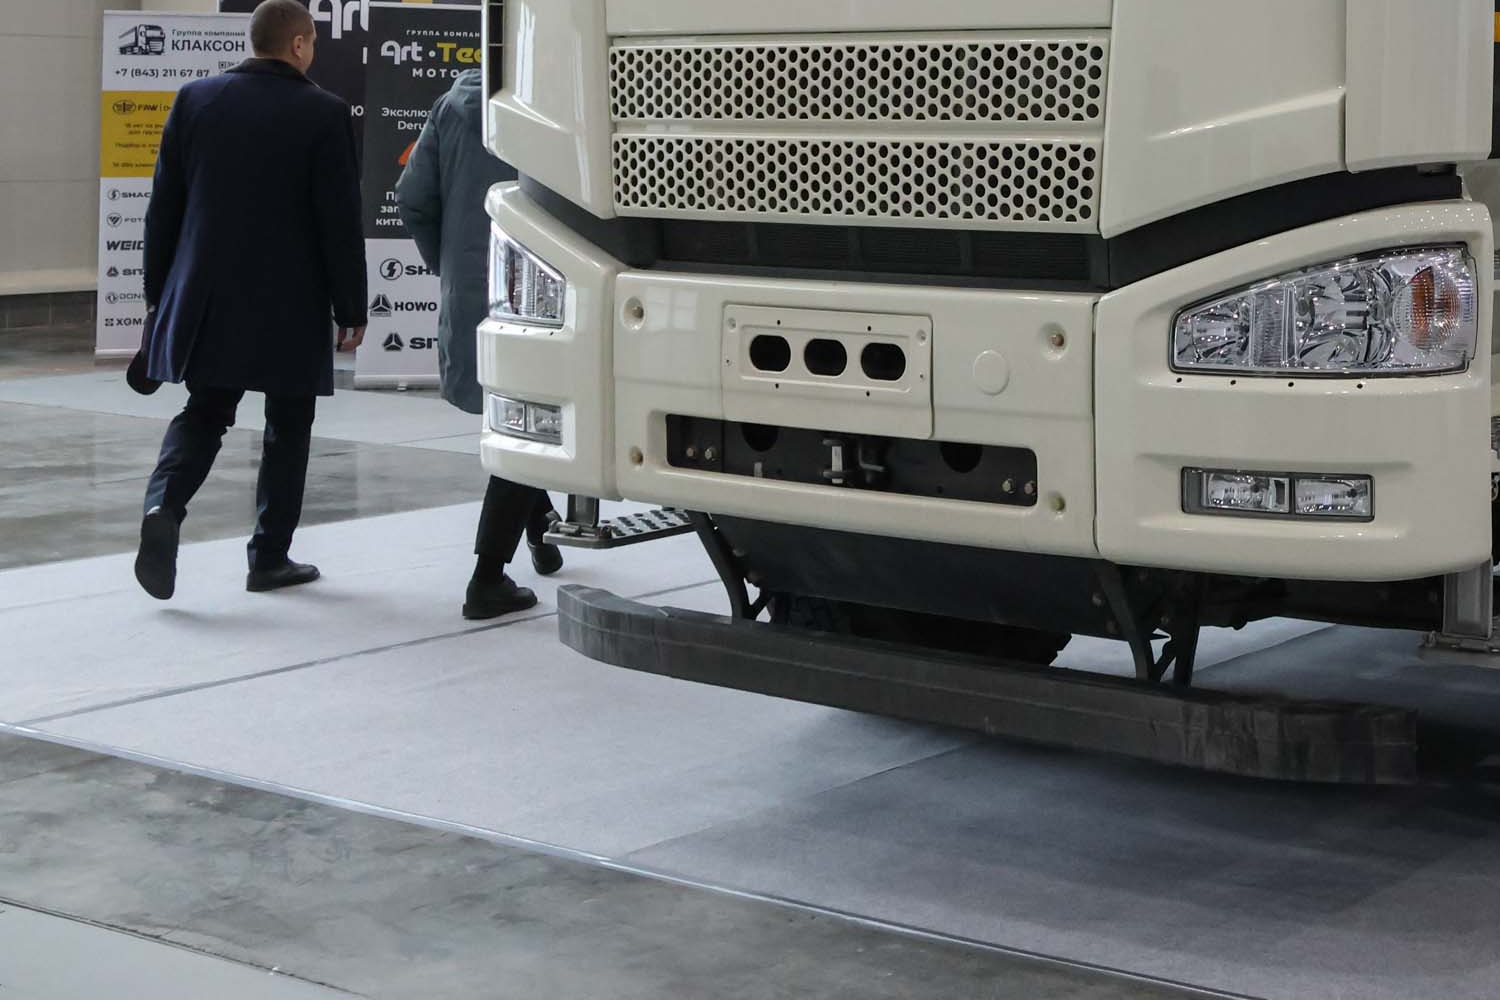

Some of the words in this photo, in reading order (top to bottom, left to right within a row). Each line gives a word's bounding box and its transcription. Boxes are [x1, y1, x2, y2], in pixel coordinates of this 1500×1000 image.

[171, 39, 246, 52] КЛАКСОН
[380, 40, 423, 65] Art
[115, 69, 128, 78] +7
[131, 68, 159, 78] (843)
[162, 69, 177, 78] 211
[180, 69, 193, 78] 67
[196, 69, 210, 78] 87
[394, 301, 438, 312] HOWO
